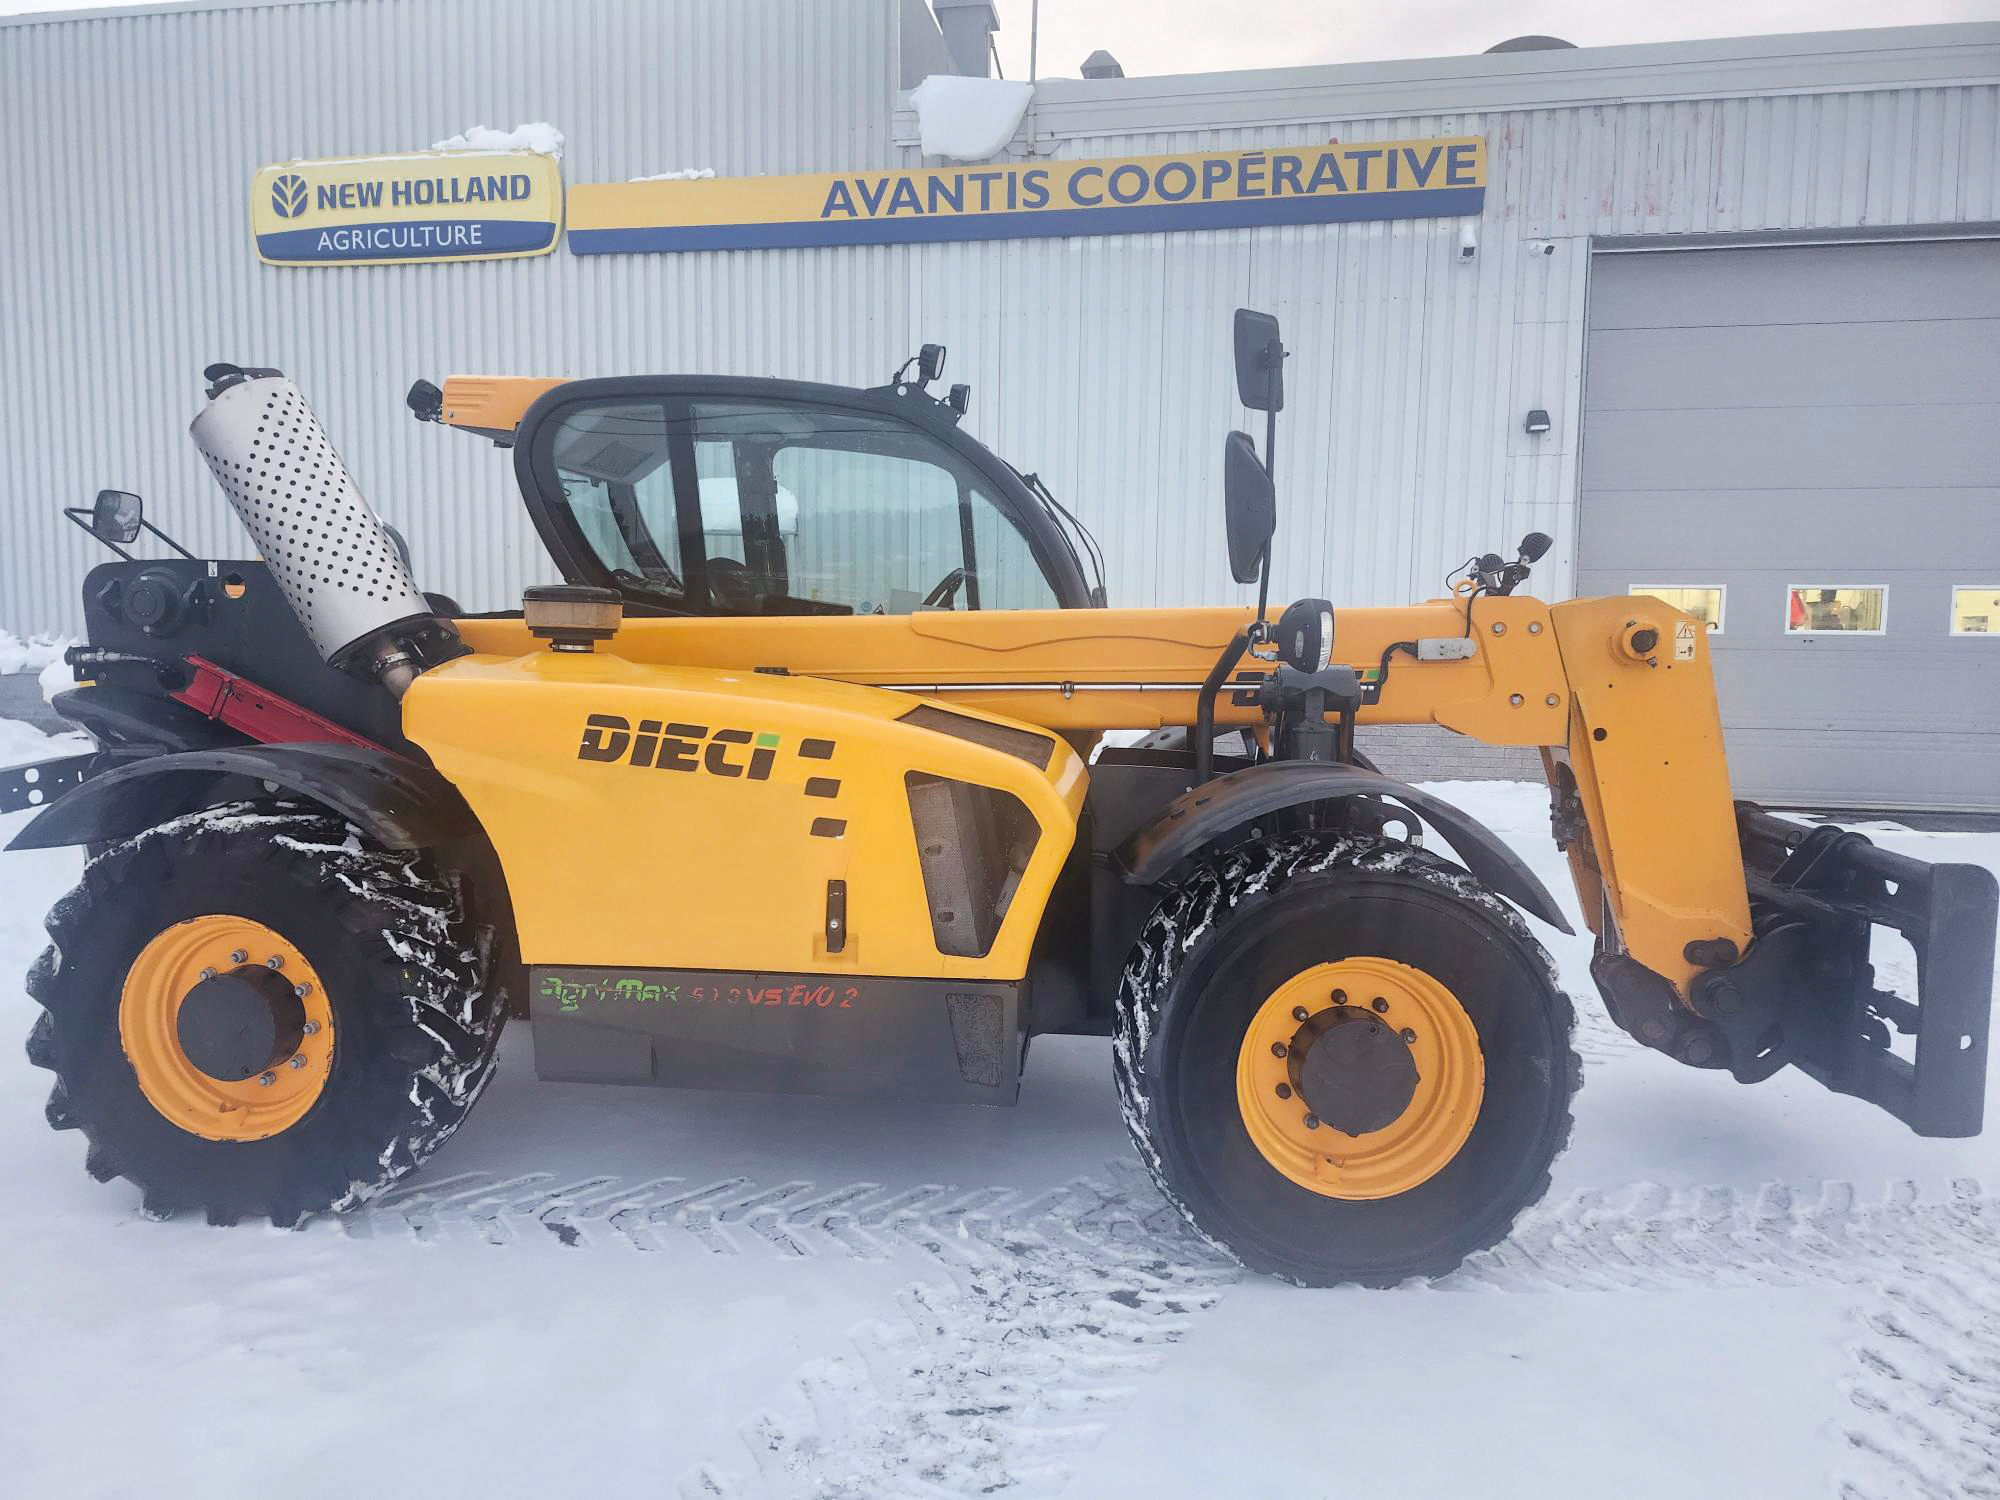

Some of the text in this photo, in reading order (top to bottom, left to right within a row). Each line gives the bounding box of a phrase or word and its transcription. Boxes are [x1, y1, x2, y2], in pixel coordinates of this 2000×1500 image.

[317, 174, 531, 210] NEW HOLLAND
[820, 143, 1477, 218] AVANTIS COOPÉRATIVE
[317, 225, 483, 252] AGRICULTURE
